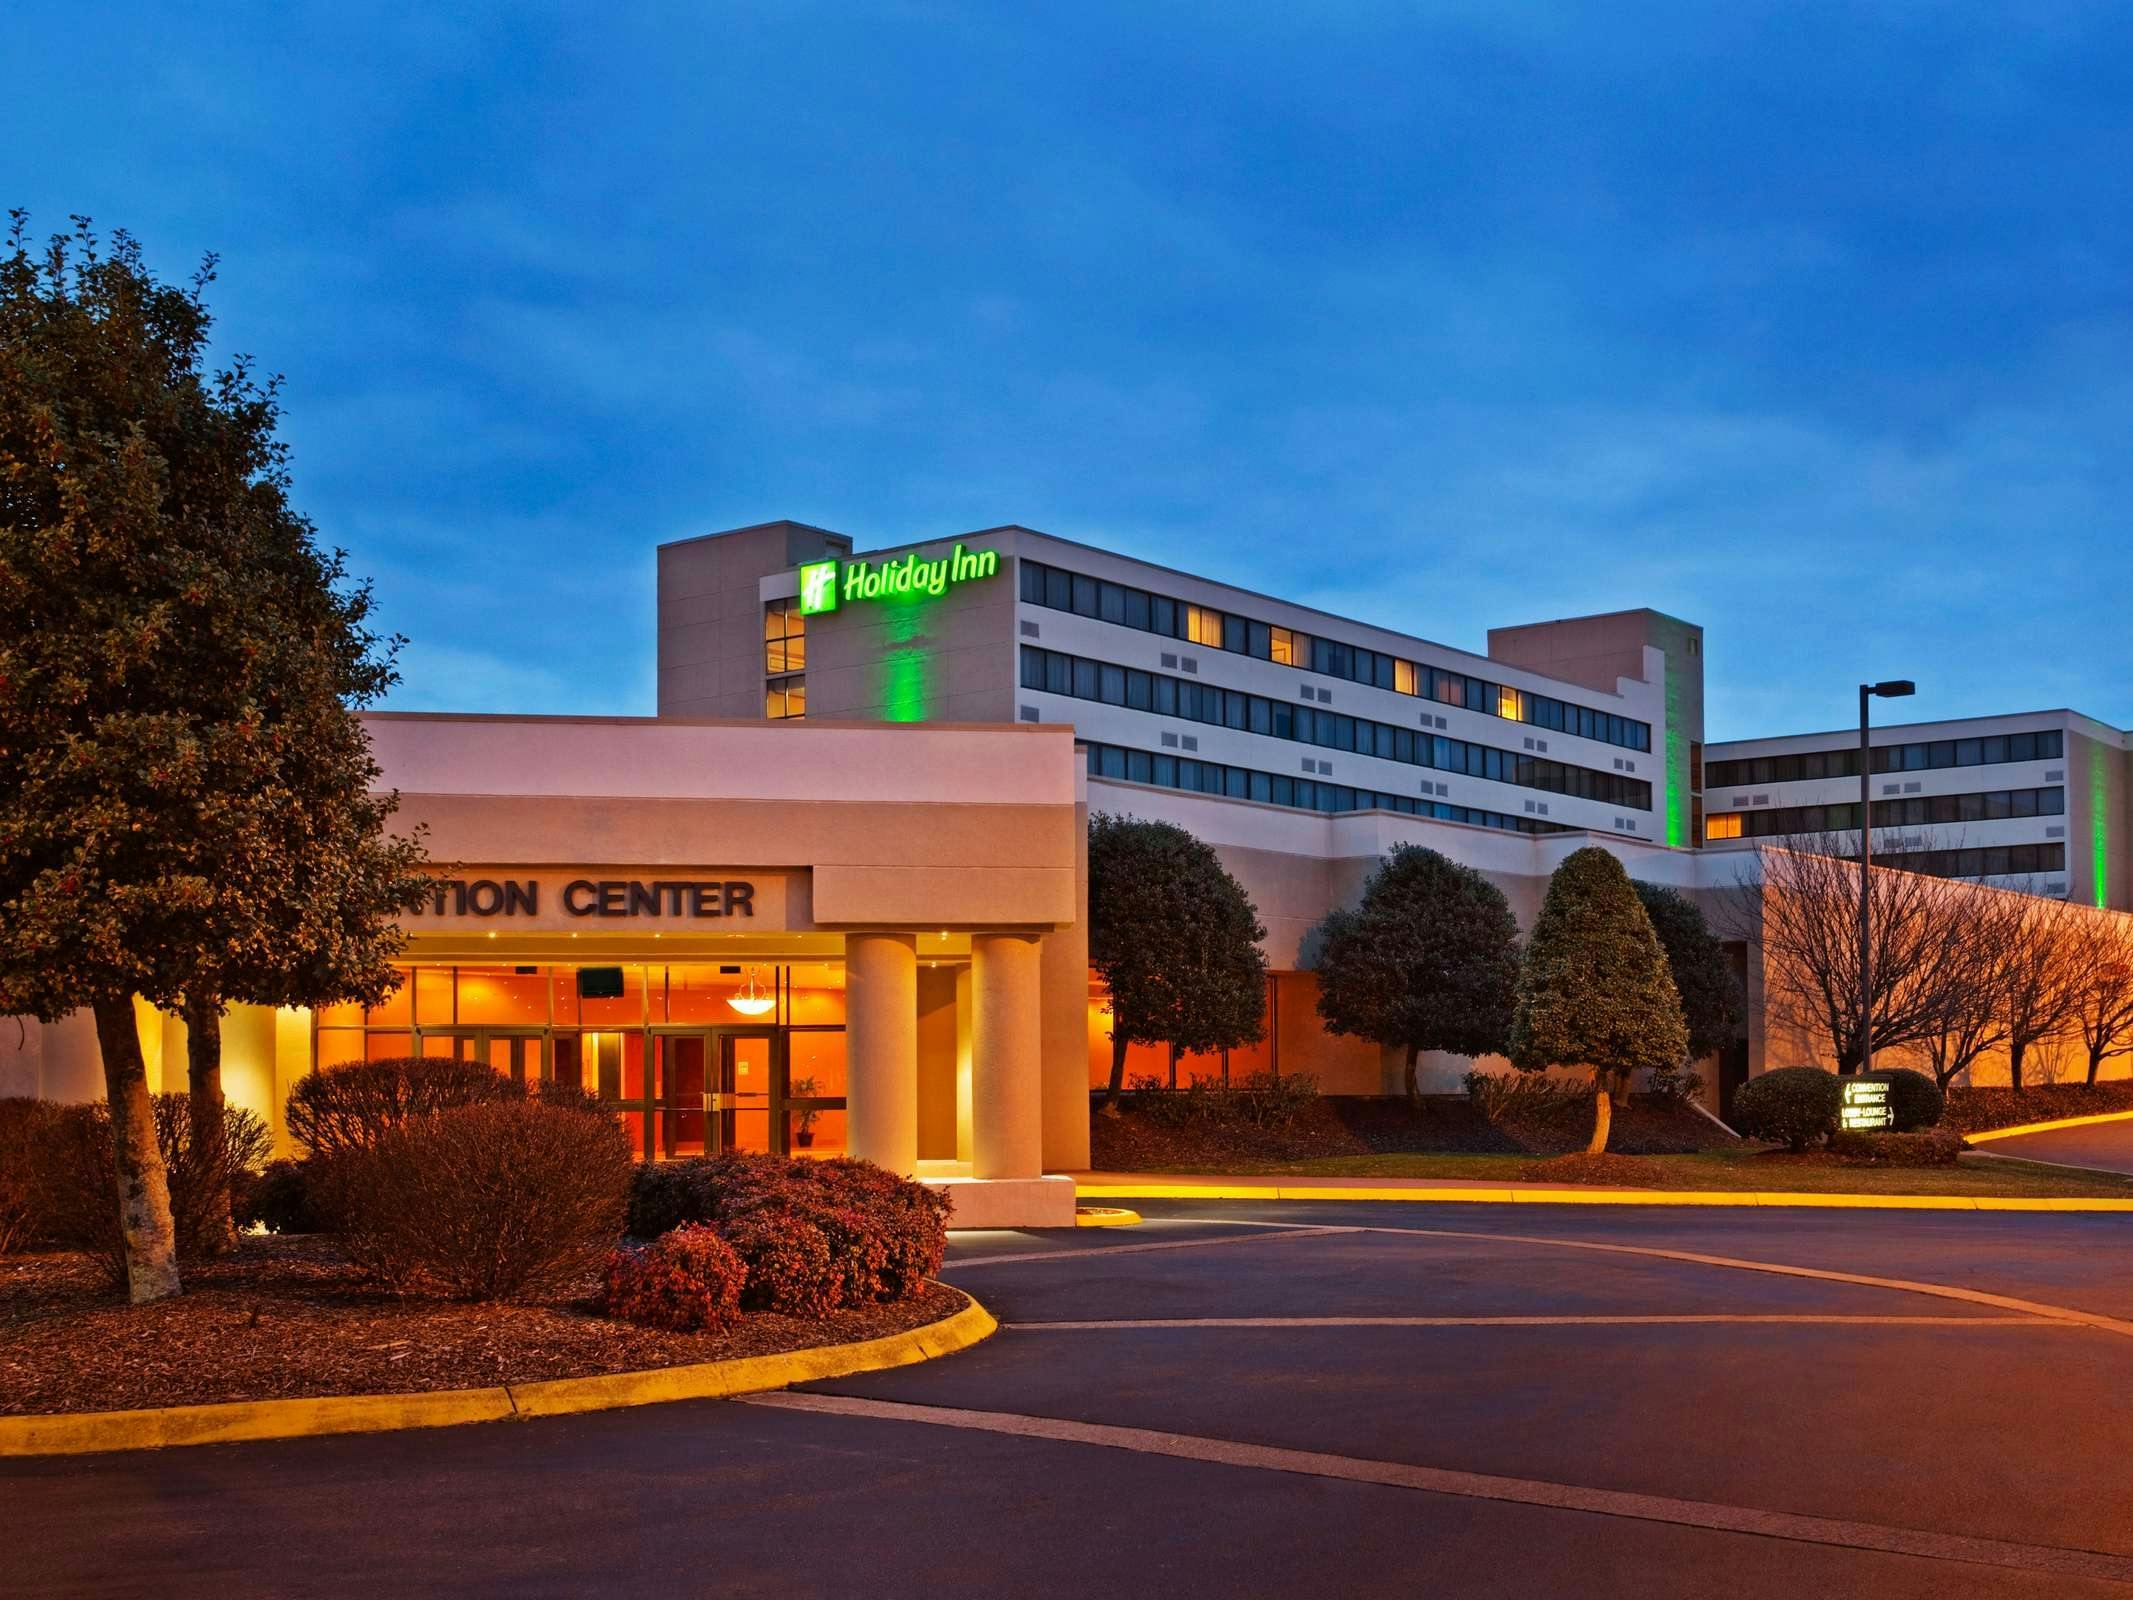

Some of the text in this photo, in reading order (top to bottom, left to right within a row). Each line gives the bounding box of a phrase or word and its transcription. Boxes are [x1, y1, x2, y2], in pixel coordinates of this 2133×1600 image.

[844, 543, 998, 601] Holiday Inn
[409, 879, 755, 918] TION CENTER
